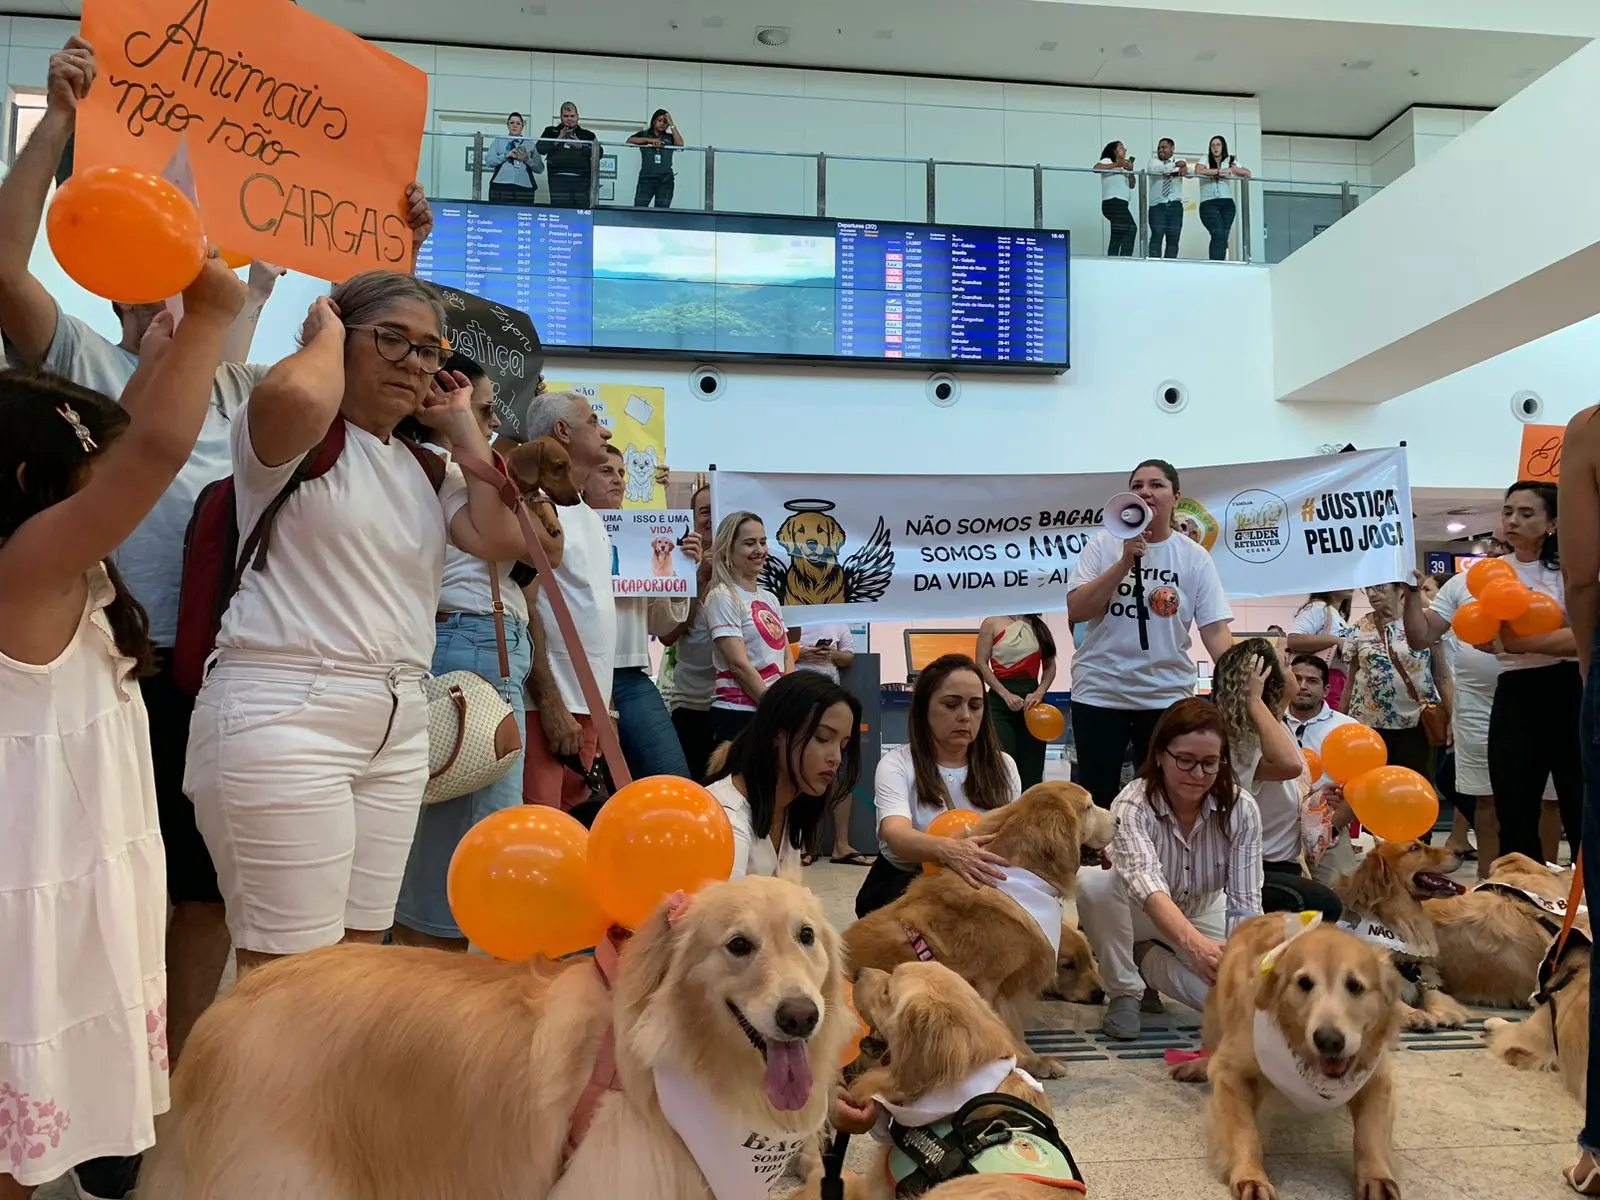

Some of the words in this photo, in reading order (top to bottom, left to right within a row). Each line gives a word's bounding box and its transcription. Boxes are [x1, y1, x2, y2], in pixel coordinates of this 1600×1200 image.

[125, 0, 348, 139] Animais
[110, 75, 204, 137] não
[240, 173, 406, 262] CARGAS
[1300, 488, 1400, 522] #JUSTIÇA
[633, 513, 657, 523] ISSO
[659, 512, 666, 523] É
[668, 514, 690, 523] UMA
[905, 514, 951, 536] NÃO
[956, 516, 1032, 535] SOMOS
[650, 525, 674, 535] VIDA
[1303, 525, 1354, 555] PELO
[920, 544, 997, 563] SOMOS
[1004, 542, 1021, 560] O
[1234, 538, 1281, 549] RETRIEVER
[1430, 560, 1446, 574] 39
[913, 573, 942, 592] DA
[946, 571, 996, 590] VIDA
[1003, 569, 1029, 588] DE
[1367, 923, 1395, 940] NÃO
